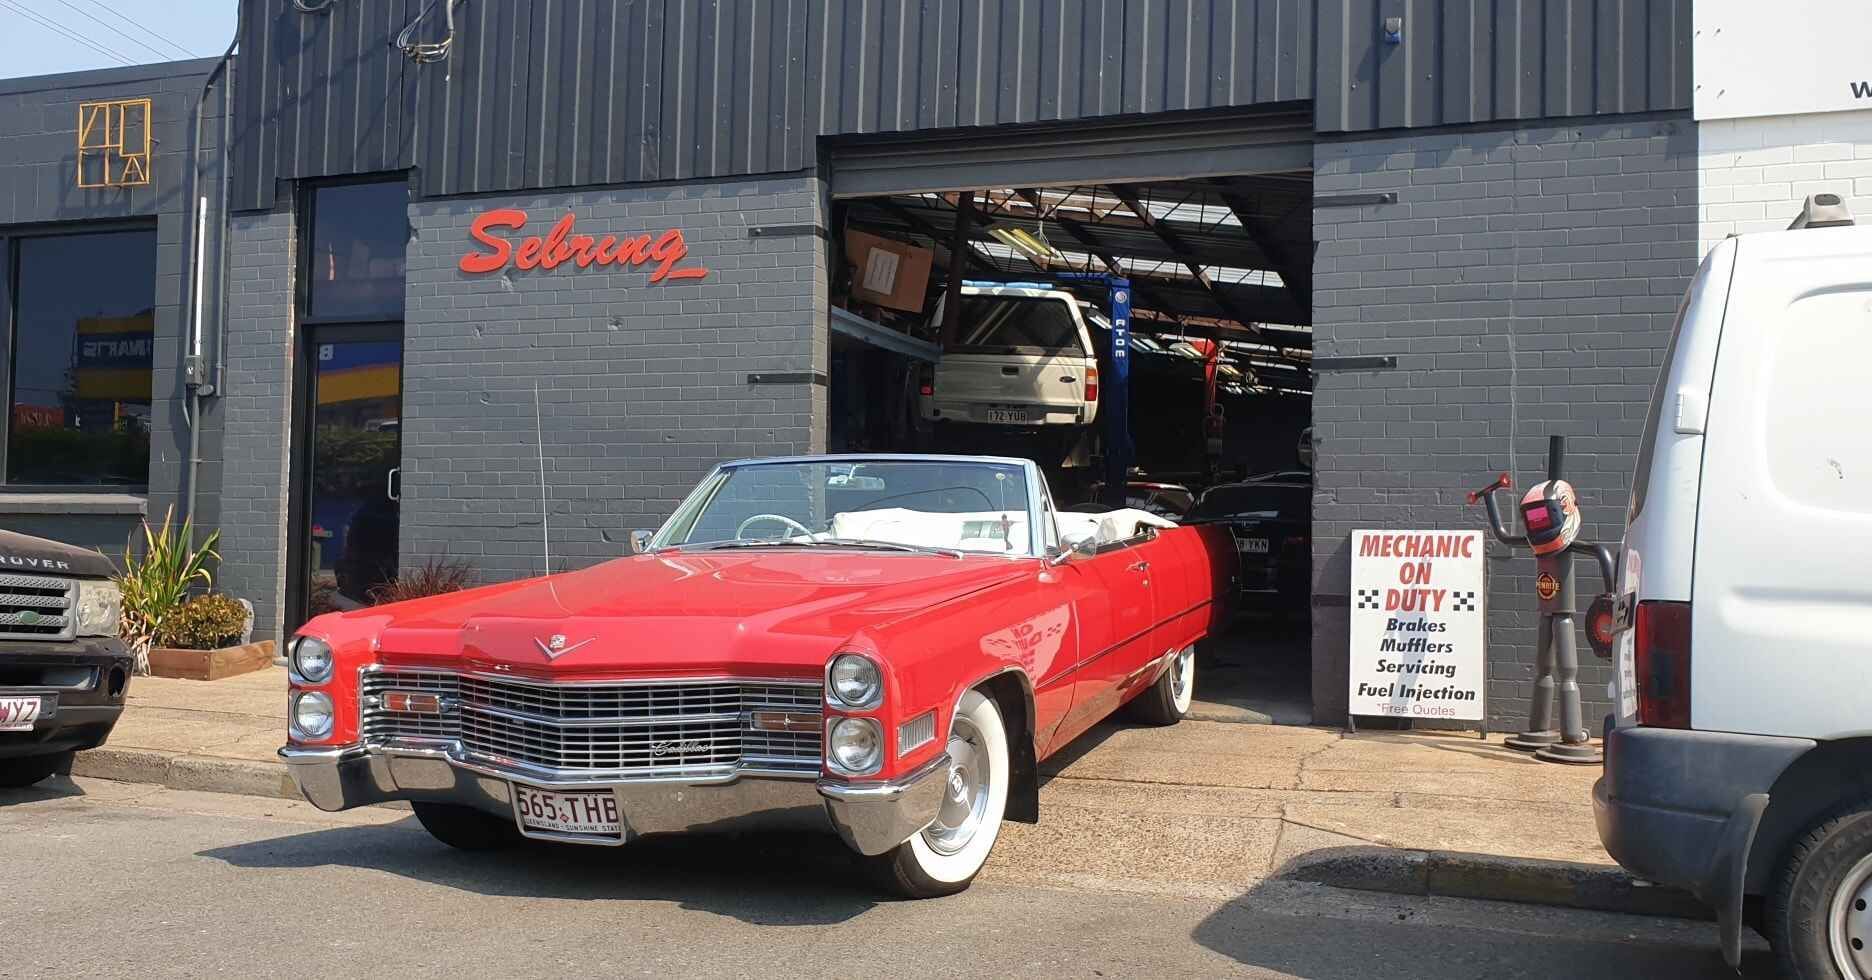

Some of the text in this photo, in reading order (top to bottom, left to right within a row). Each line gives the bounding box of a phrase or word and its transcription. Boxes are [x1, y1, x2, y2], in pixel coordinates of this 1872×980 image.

[459, 208, 708, 283] Sebring
[1360, 534, 1475, 558] MECHANIC
[1399, 561, 1432, 585] ON
[1385, 588, 1447, 612] DUTY
[1386, 617, 1447, 633] Brakes
[1380, 638, 1454, 653] Mufflers
[1376, 659, 1456, 678] Servicing
[1358, 682, 1476, 701] Fuel Injection
[1413, 704, 1456, 716] Quotes
